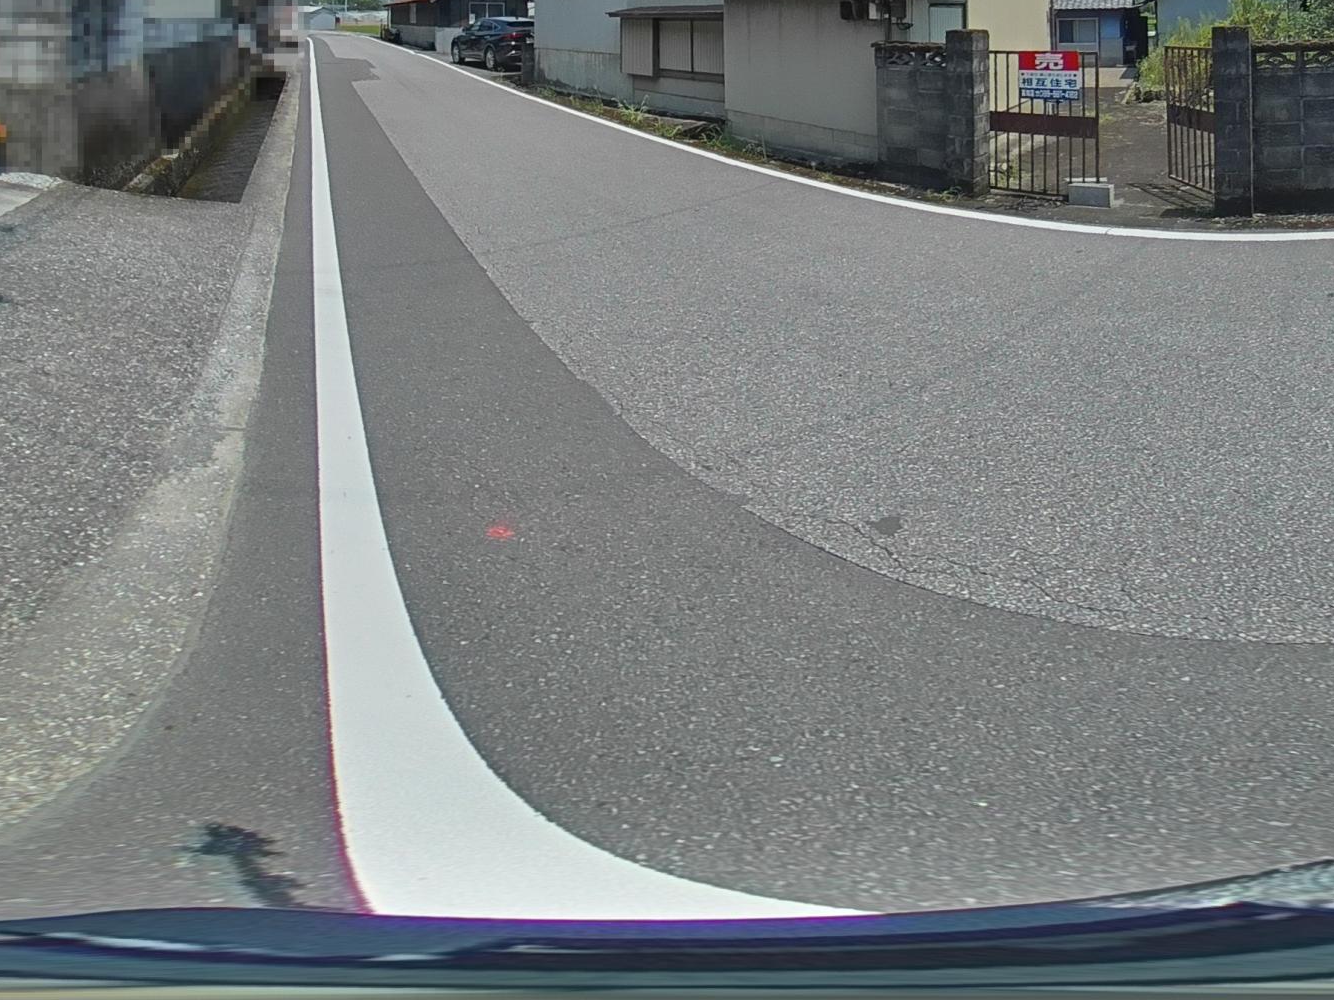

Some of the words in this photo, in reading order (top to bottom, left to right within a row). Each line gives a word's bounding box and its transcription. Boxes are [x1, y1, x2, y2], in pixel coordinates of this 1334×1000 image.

[1035, 53, 1063, 69] 売
[1022, 77, 1077, 88] 相互住宅
